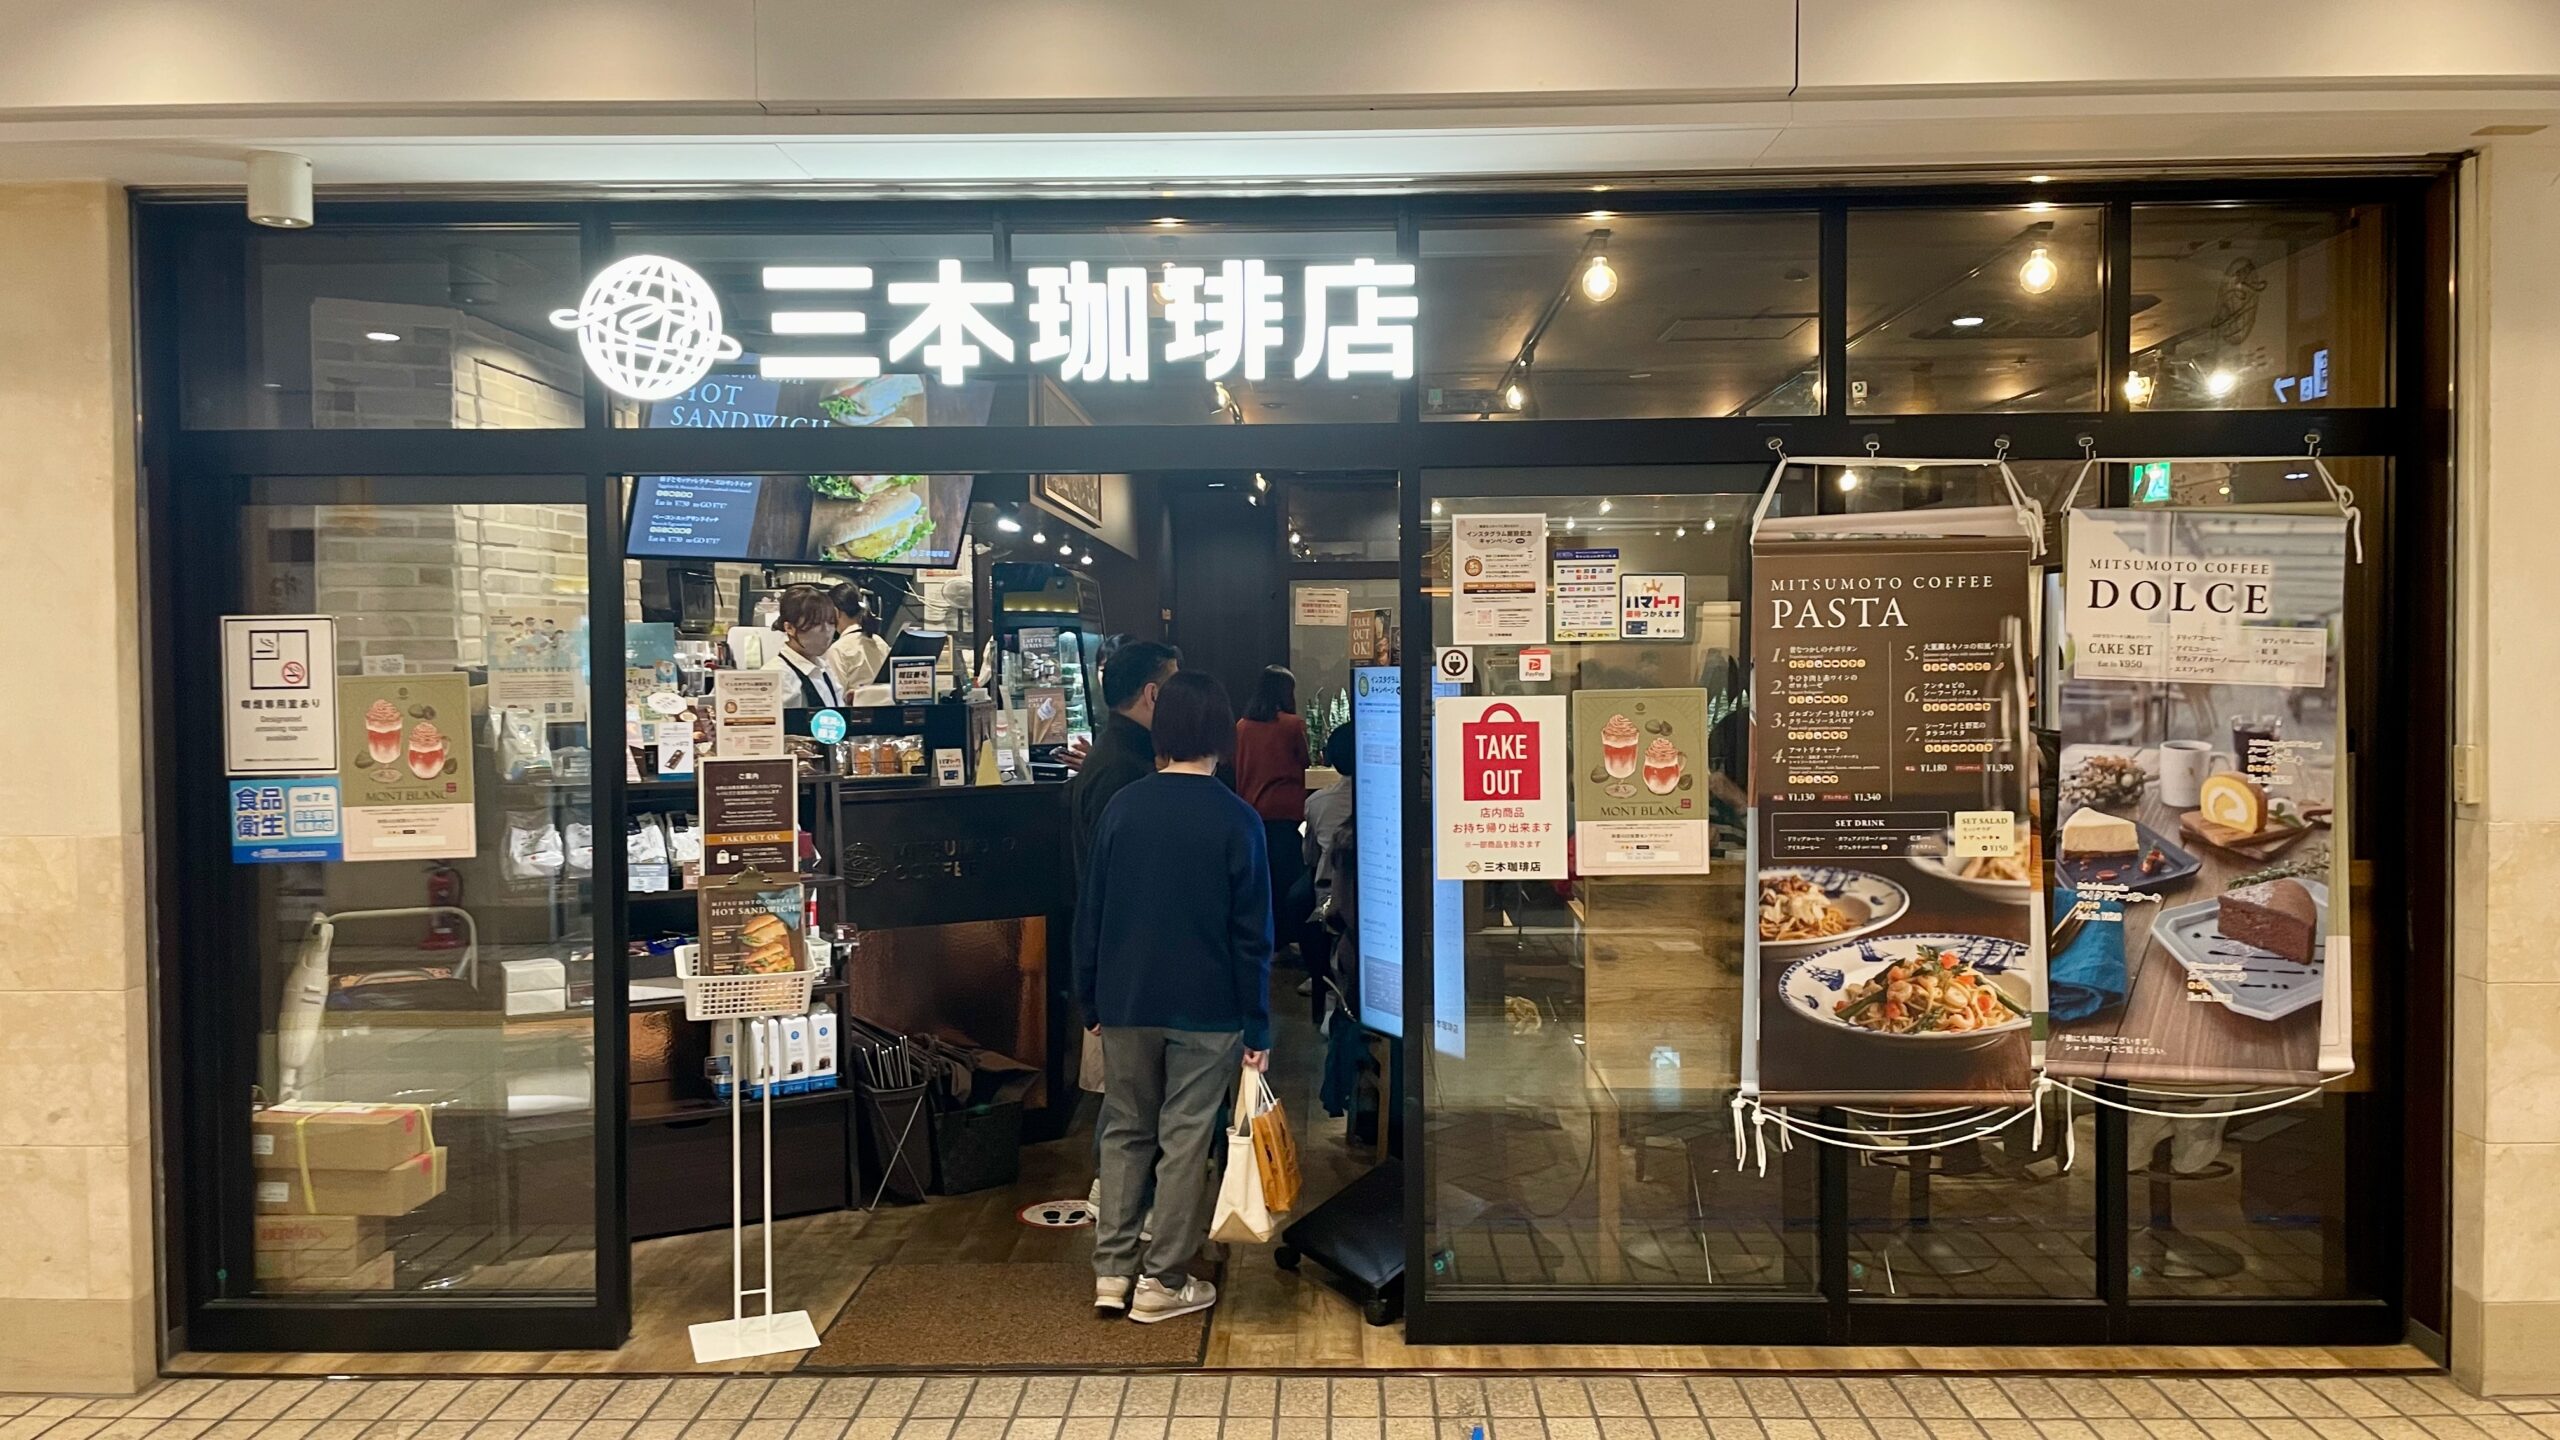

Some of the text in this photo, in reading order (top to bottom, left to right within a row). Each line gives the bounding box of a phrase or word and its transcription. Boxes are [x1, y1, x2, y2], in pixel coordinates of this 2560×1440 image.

[760, 258, 1419, 385] 三本珈琲店
[2089, 558, 2271, 575] MITSUMOTO COFFEE
[1770, 575, 1994, 591] MITSUMOTO COFFEE
[1626, 595, 1680, 608] ハマトク
[2087, 579, 2270, 615] DOLCE
[1770, 597, 1909, 629] PASTA
[1904, 645, 1919, 661] 5.
[2088, 642, 2154, 656] CAKE SET
[1904, 686, 1919, 703] 6.
[1770, 712, 1786, 728] 3.
[1905, 726, 1920, 743] 7.
[1475, 734, 1528, 760] TAKE
[1482, 769, 1522, 795] OUT
[236, 787, 283, 811] 食品
[365, 791, 402, 801] MONT
[1480, 807, 1525, 818] 店内商品
[1600, 805, 1684, 816] MONT BLANC
[236, 813, 285, 837] 衛生
[1452, 822, 1552, 834] お持ち帰り出来ます
[1835, 818, 1886, 827] SET DRINK
[1979, 817, 2008, 825] SALAD
[720, 835, 745, 843] TAKE
[1484, 861, 1541, 872] 三本珈琲店
[711, 905, 797, 916] HOT SANDWICH
